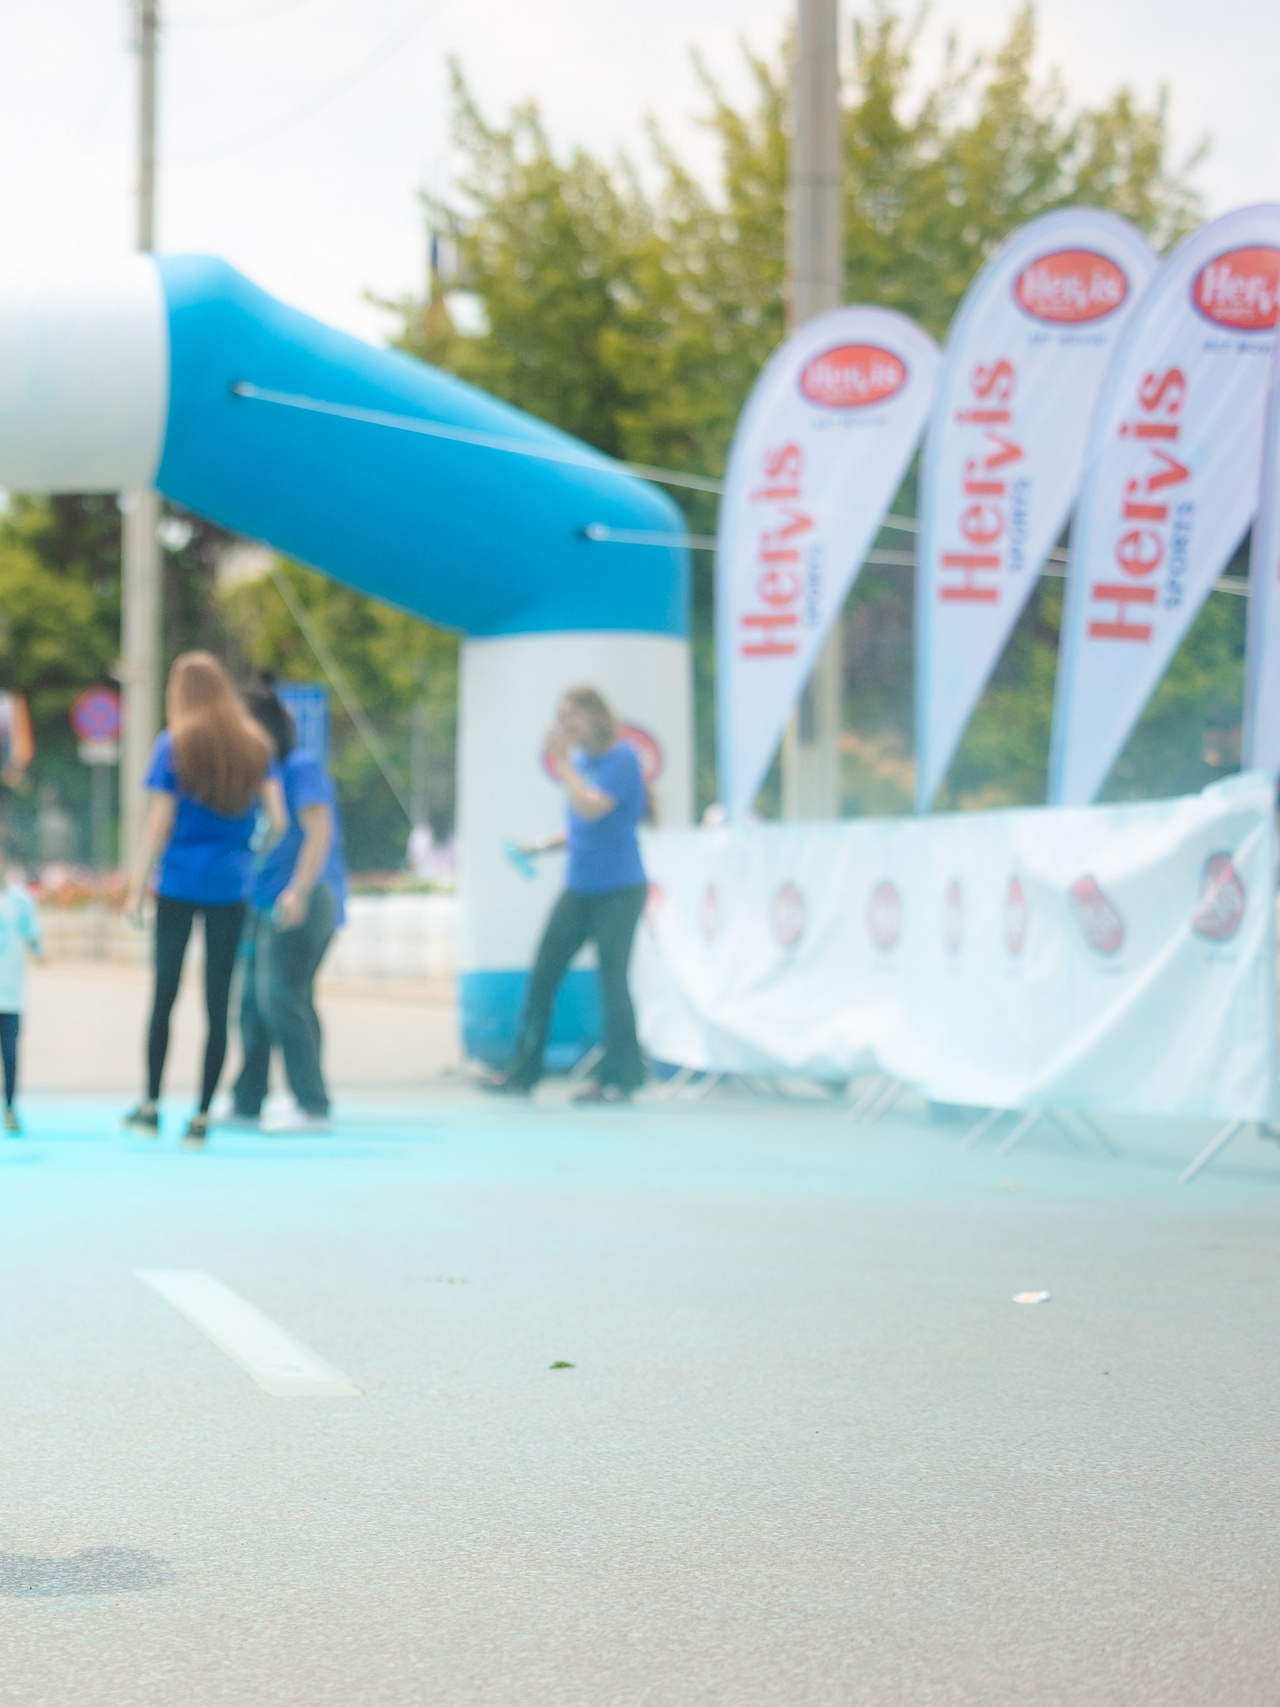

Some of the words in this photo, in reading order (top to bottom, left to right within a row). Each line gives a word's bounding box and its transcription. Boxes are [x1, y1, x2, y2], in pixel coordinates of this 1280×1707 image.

[740, 440, 814, 661] Hervis
[939, 357, 1025, 606] Hervis
[1087, 364, 1190, 645] Hervis
[1163, 500, 1195, 609] SPORTS
